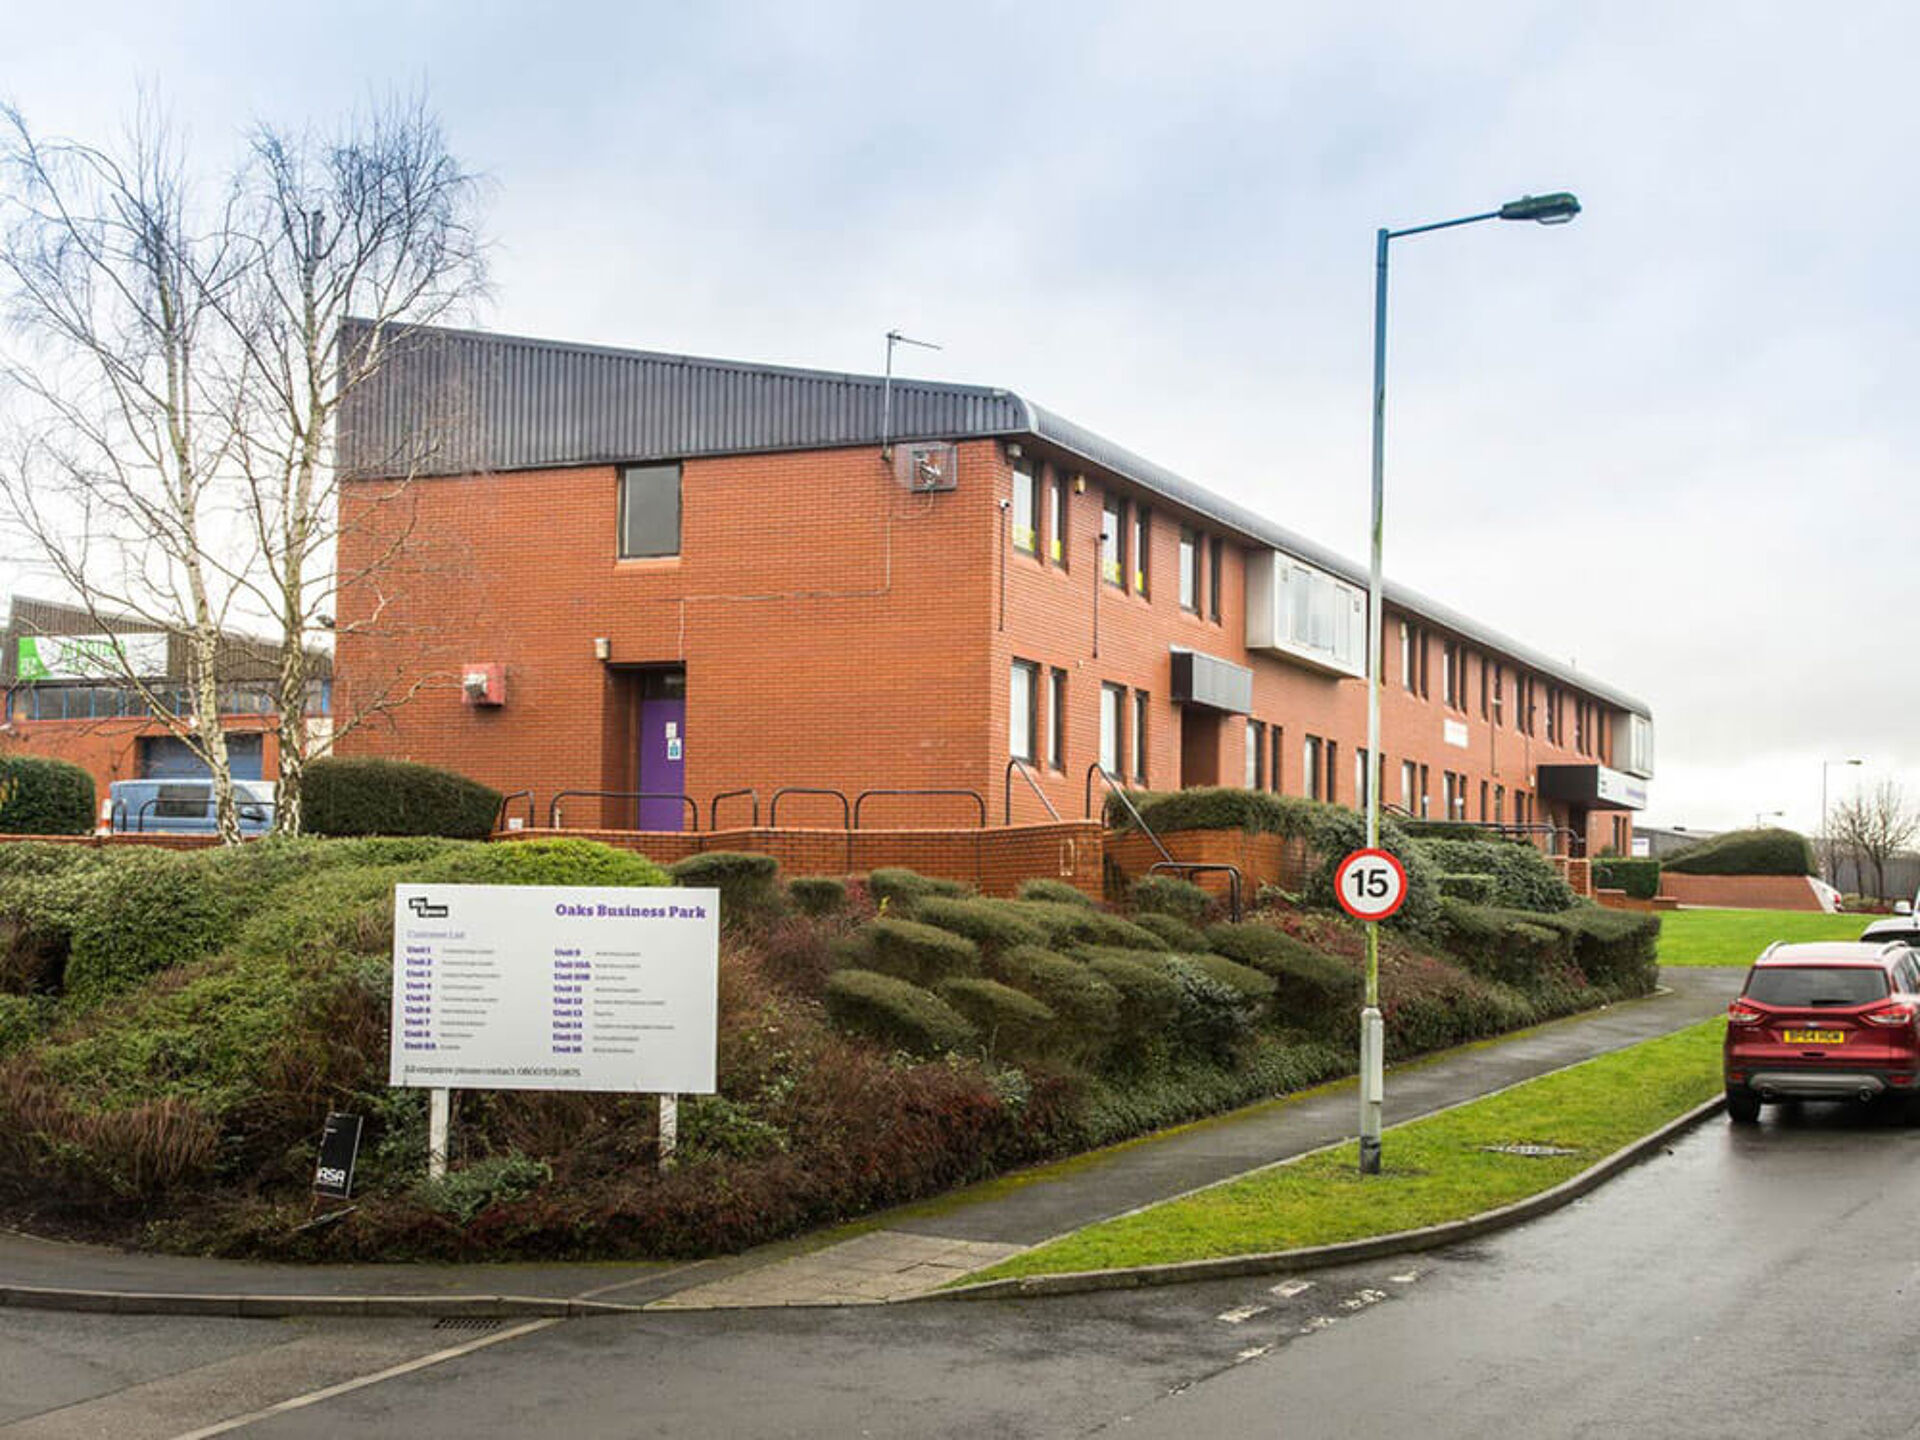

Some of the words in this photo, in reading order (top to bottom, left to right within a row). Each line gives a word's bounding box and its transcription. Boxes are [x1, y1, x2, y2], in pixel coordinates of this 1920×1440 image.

[1351, 869, 1388, 897] 15
[555, 903, 594, 917] Oaks
[596, 904, 666, 918] Business
[669, 905, 706, 919] Park
[554, 949, 574, 957] Unit
[405, 994, 424, 1002] Unit
[553, 997, 572, 1005] Unit
[405, 1006, 424, 1014] Unit
[553, 1009, 572, 1017] Unit
[552, 1021, 572, 1029] Unit
[552, 1033, 571, 1041] Unit
[404, 1042, 424, 1050] Unit
[552, 1045, 571, 1053] Unit
